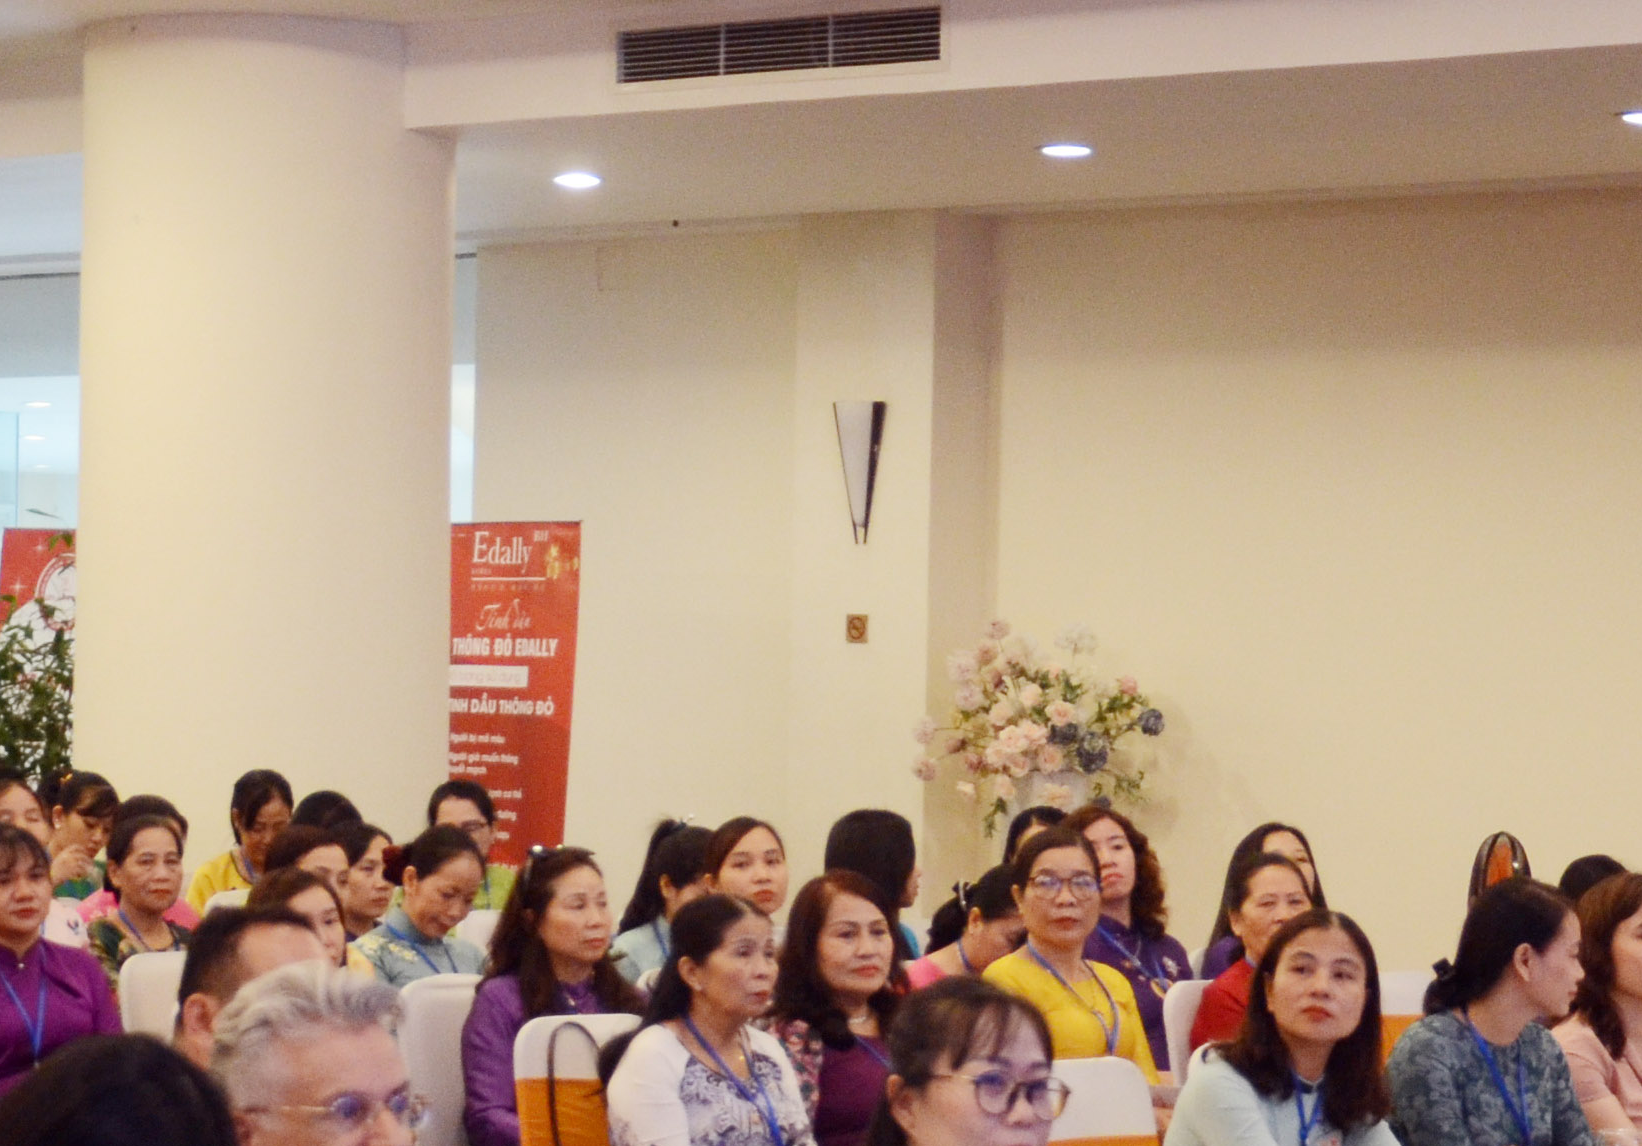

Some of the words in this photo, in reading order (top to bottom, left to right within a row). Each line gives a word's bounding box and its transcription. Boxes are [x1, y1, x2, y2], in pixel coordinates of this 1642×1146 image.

[473, 531, 533, 574] Edally
[515, 638, 558, 656] EDALLY
[470, 692, 496, 713] DẦU
